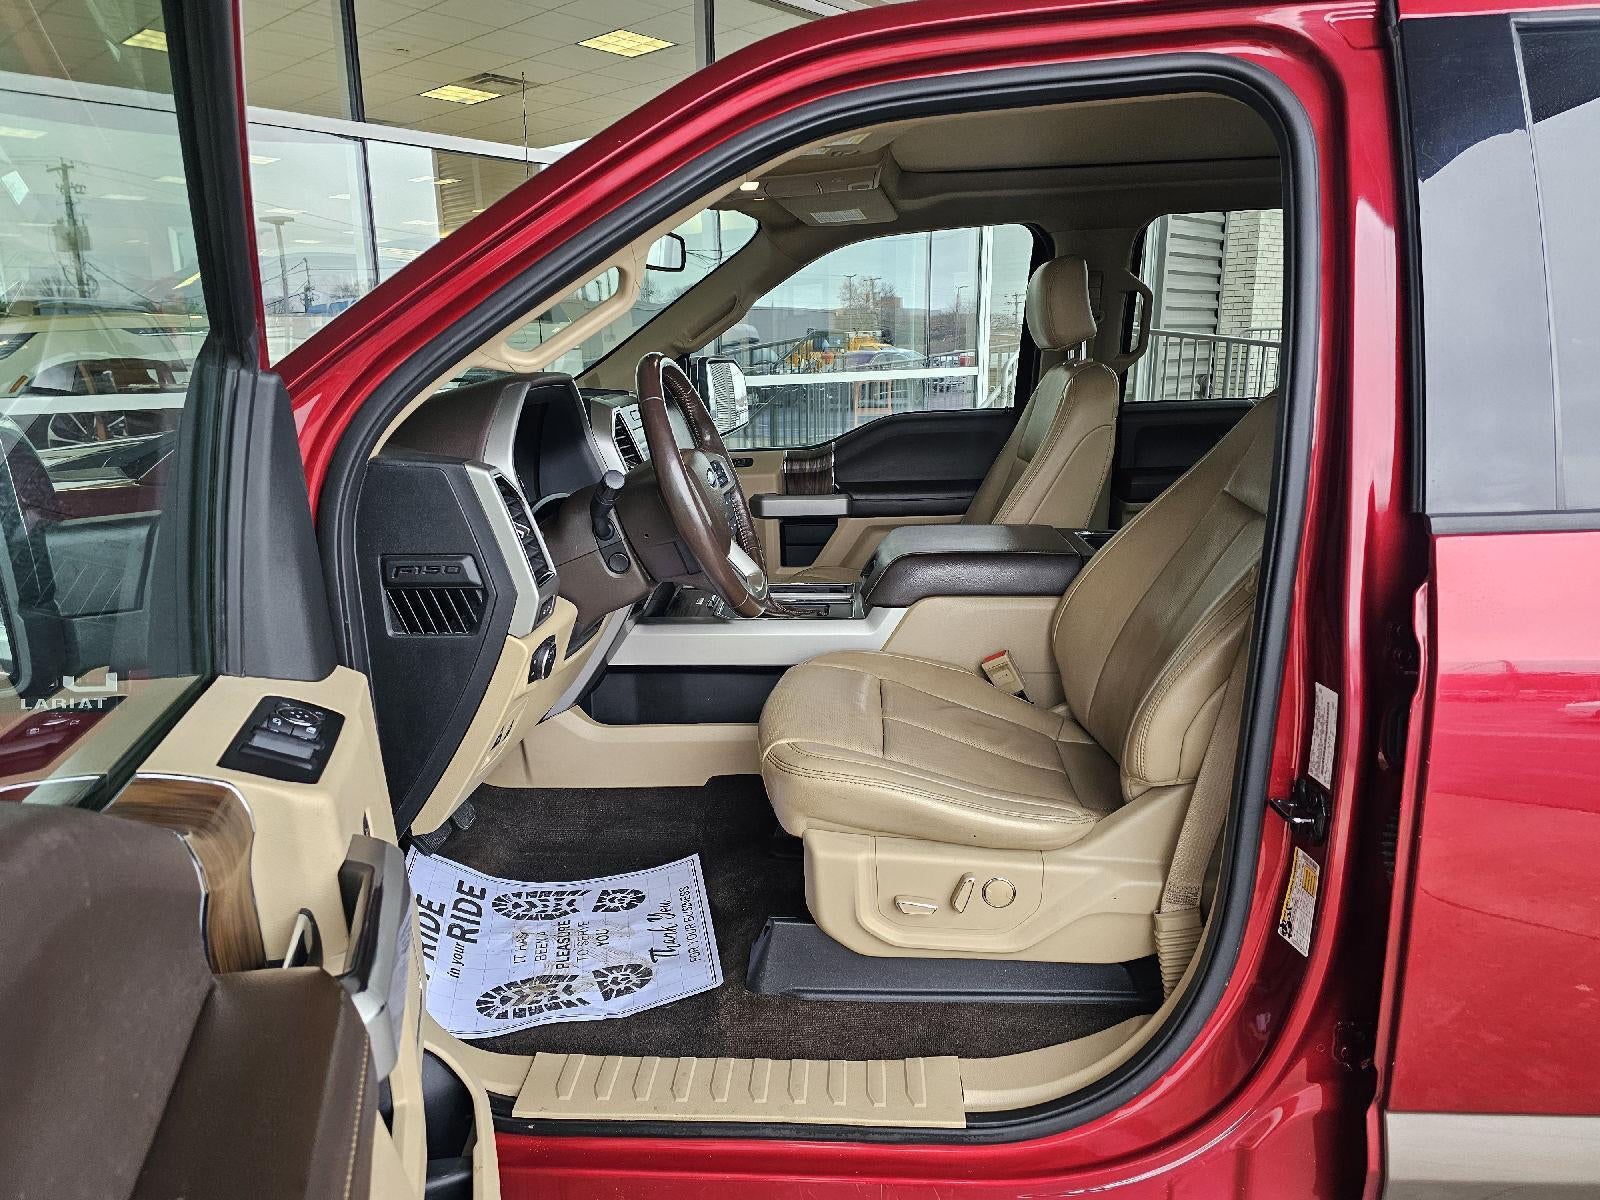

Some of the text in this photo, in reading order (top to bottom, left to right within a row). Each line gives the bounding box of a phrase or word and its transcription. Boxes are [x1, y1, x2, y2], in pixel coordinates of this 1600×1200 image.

[20, 697, 108, 711] LARIAT
[446, 879, 487, 979] in your RIDE
[555, 919, 571, 970] PLEASURE
[576, 920, 590, 963] TO SERVE
[595, 928, 610, 947] YOU
[646, 923, 682, 964] Thank
[679, 885, 702, 963] FOR YOUR BUSINESS
[513, 954, 527, 965] IT
[534, 938, 549, 962] BEEN
